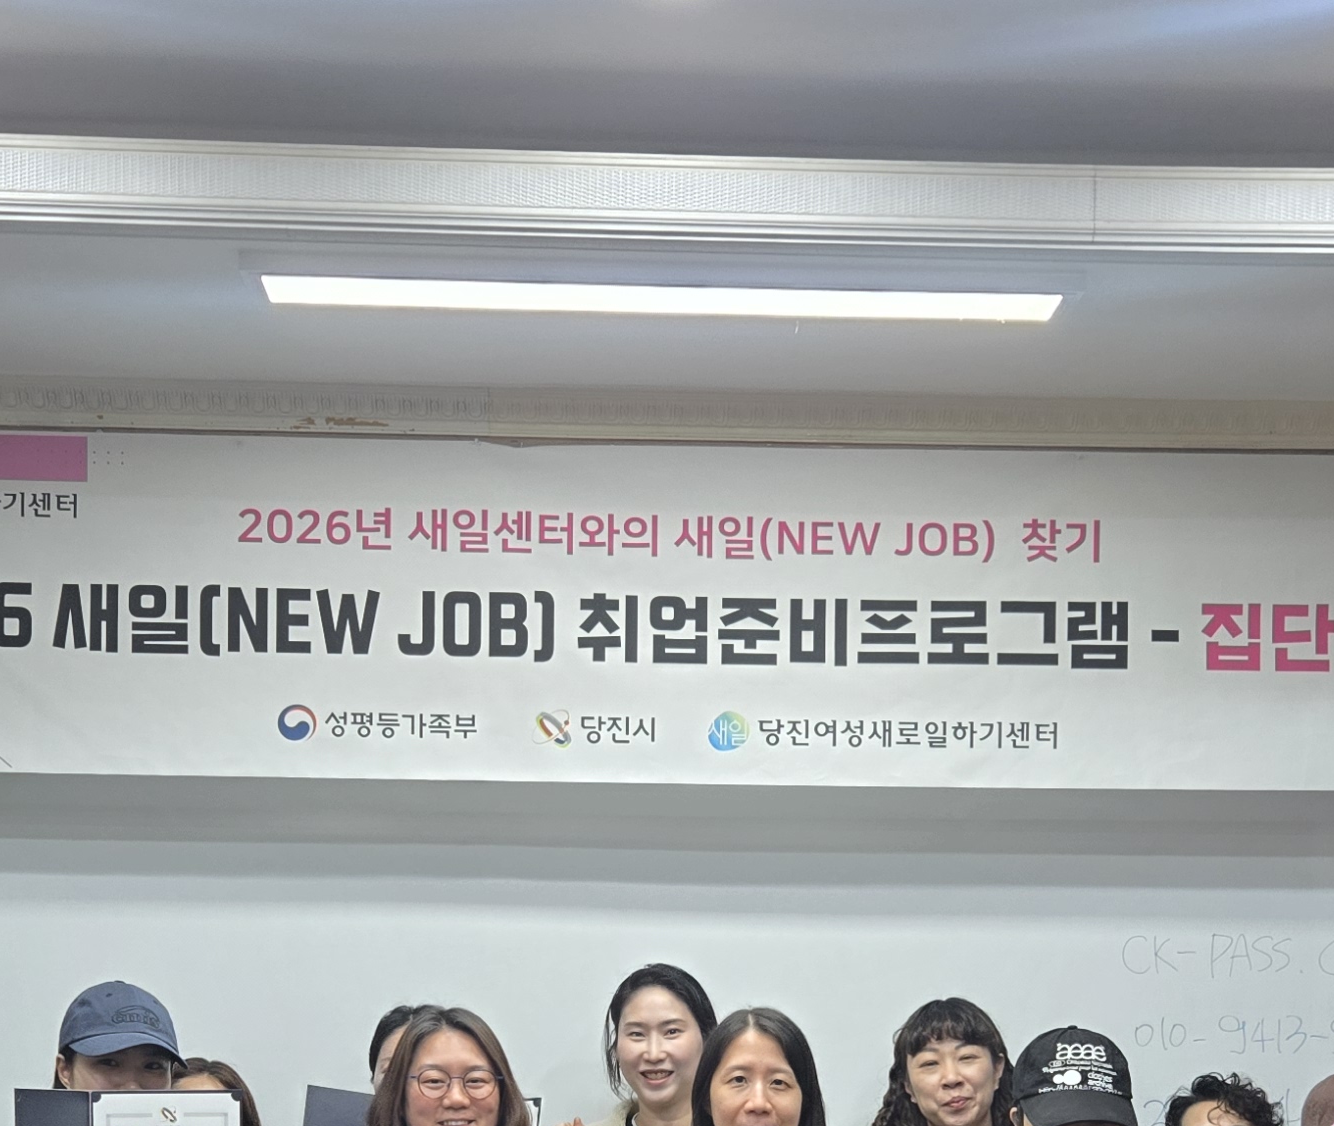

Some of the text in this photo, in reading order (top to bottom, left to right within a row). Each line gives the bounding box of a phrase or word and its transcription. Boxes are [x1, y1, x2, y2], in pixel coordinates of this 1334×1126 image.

[237, 507, 1102, 565] 2026년 새일센터와의 새일(NEW JOB) 찾기
[397, 590, 555, 663] JOB)
[577, 592, 1130, 671] 취업준비프로그램
[323, 709, 478, 742] 성평등가족부
[579, 713, 657, 746] 당진시
[757, 716, 1059, 751] 당진여성새로일하기센터
